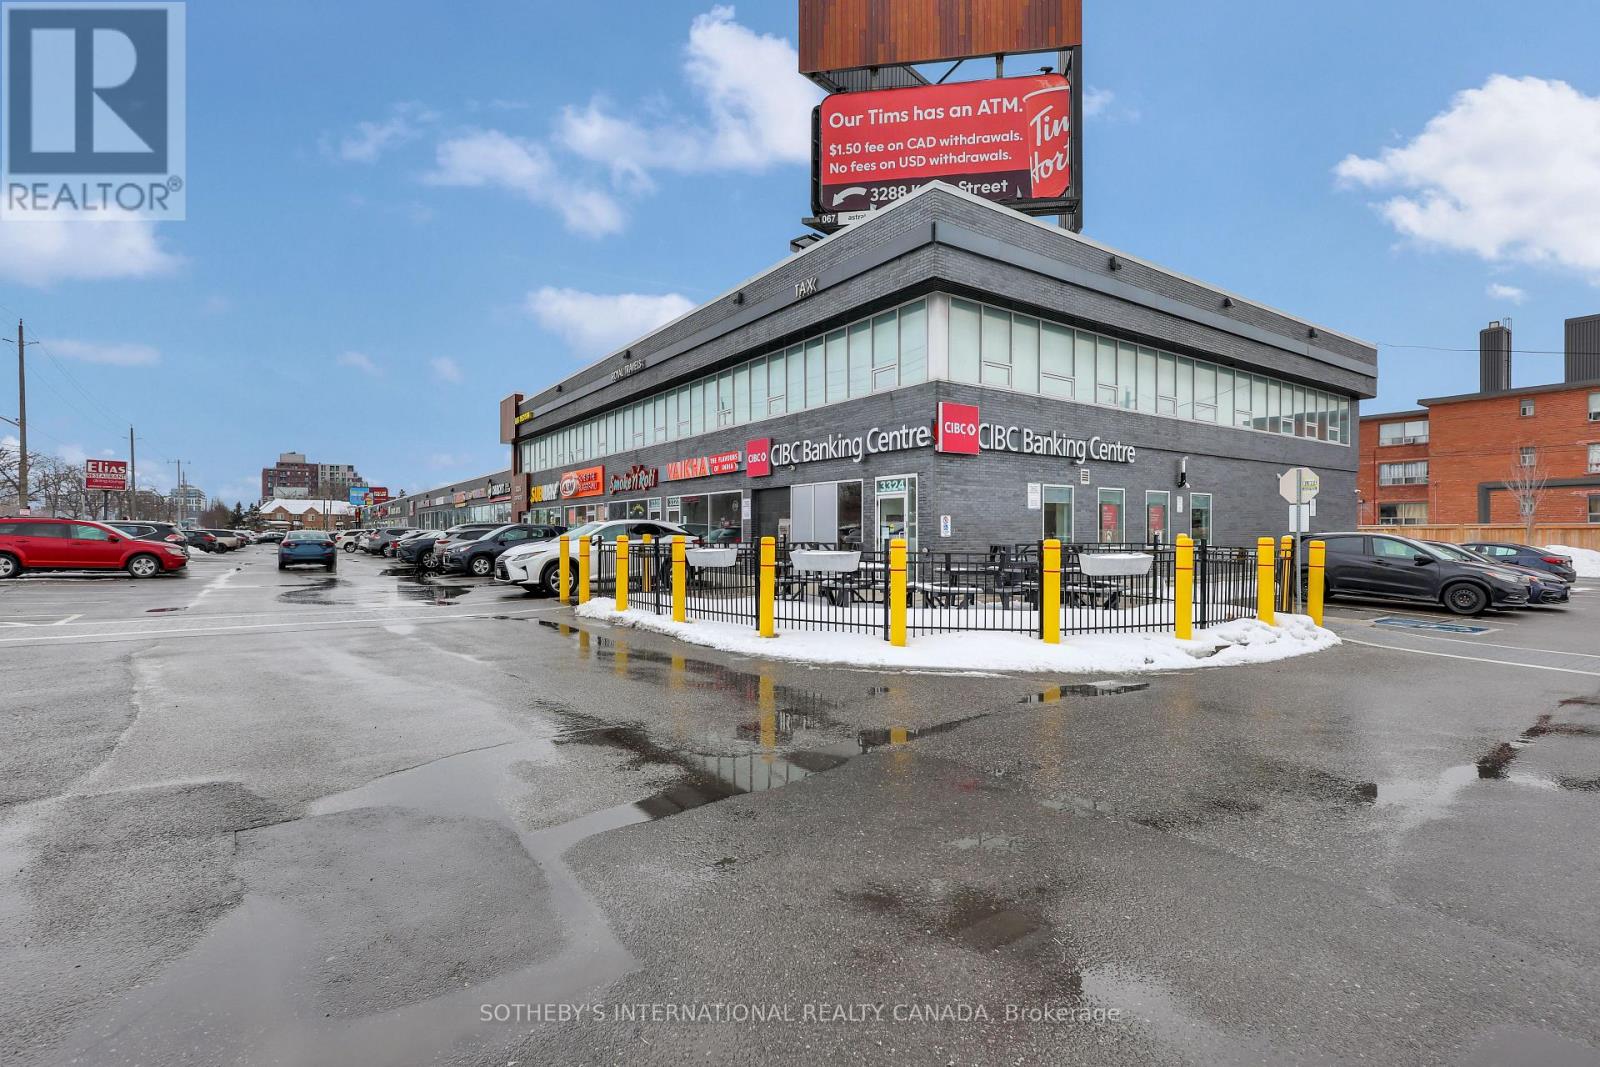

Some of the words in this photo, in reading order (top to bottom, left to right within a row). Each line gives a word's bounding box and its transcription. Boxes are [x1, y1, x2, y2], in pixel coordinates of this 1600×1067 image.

[829, 112, 864, 128] Our
[868, 109, 909, 125] Tims
[913, 106, 945, 121] has
[949, 105, 973, 118] an
[977, 97, 1023, 116] ATM.
[829, 143, 862, 157] $1.50
[865, 142, 885, 153] fee
[887, 142, 904, 151] on
[907, 136, 937, 149] CAD
[939, 130, 1023, 146] withdrawals.
[829, 163, 848, 174] No
[850, 161, 876, 173] fees
[879, 160, 896, 170] on
[899, 156, 926, 168] USD
[929, 149, 1012, 166] withdrawals.
[870, 185, 907, 202] 3288
[822, 214, 836, 223] 067
[944, 422, 967, 435] CIBC
[771, 441, 800, 467] CIBC
[803, 434, 863, 463] Banking
[866, 424, 930, 453] Centre
[978, 423, 1019, 452] CIBC
[1023, 430, 1087, 465] Banking
[1089, 436, 1136, 463] Centre
[748, 453, 761, 463] CIBC
[530, 482, 560, 503] SUBWAY
[880, 479, 905, 492] 3324
